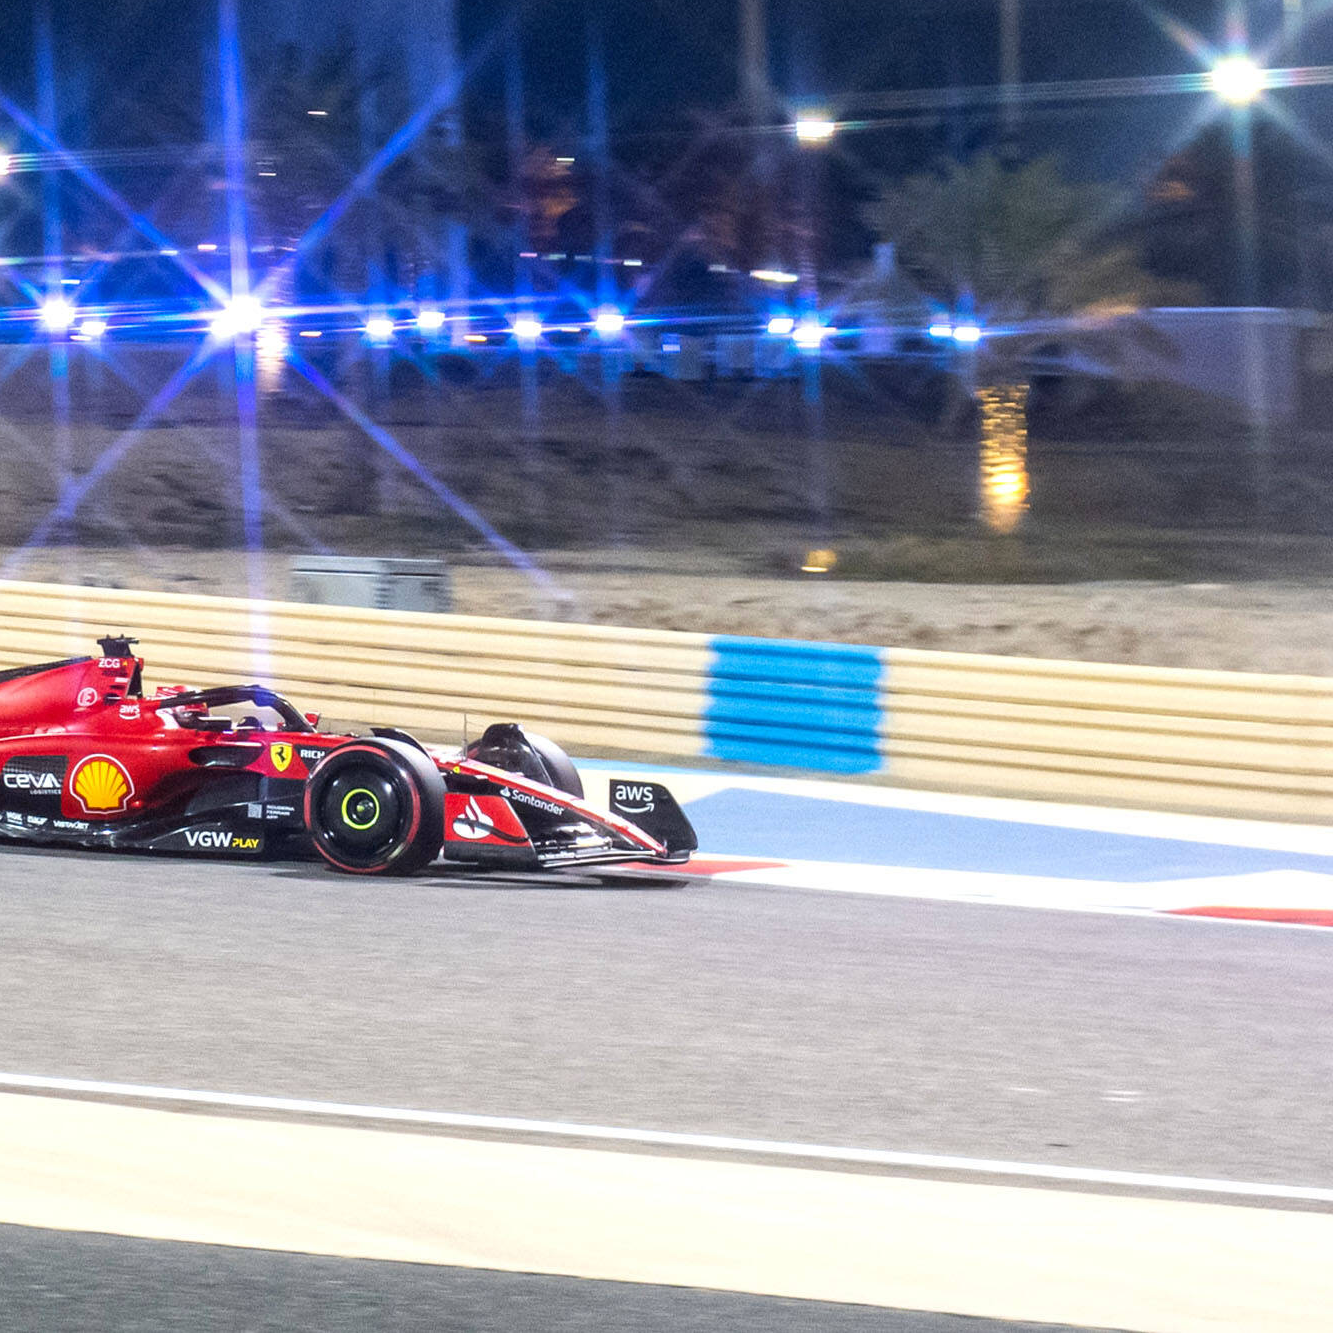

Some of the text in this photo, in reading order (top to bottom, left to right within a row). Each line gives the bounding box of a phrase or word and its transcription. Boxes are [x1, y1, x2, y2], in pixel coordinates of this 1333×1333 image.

[98, 657, 121, 668] ZCG
[119, 705, 140, 714] aws
[615, 785, 653, 802] aws
[511, 790, 565, 816] Santander
[185, 831, 260, 848] VGW PLAY
